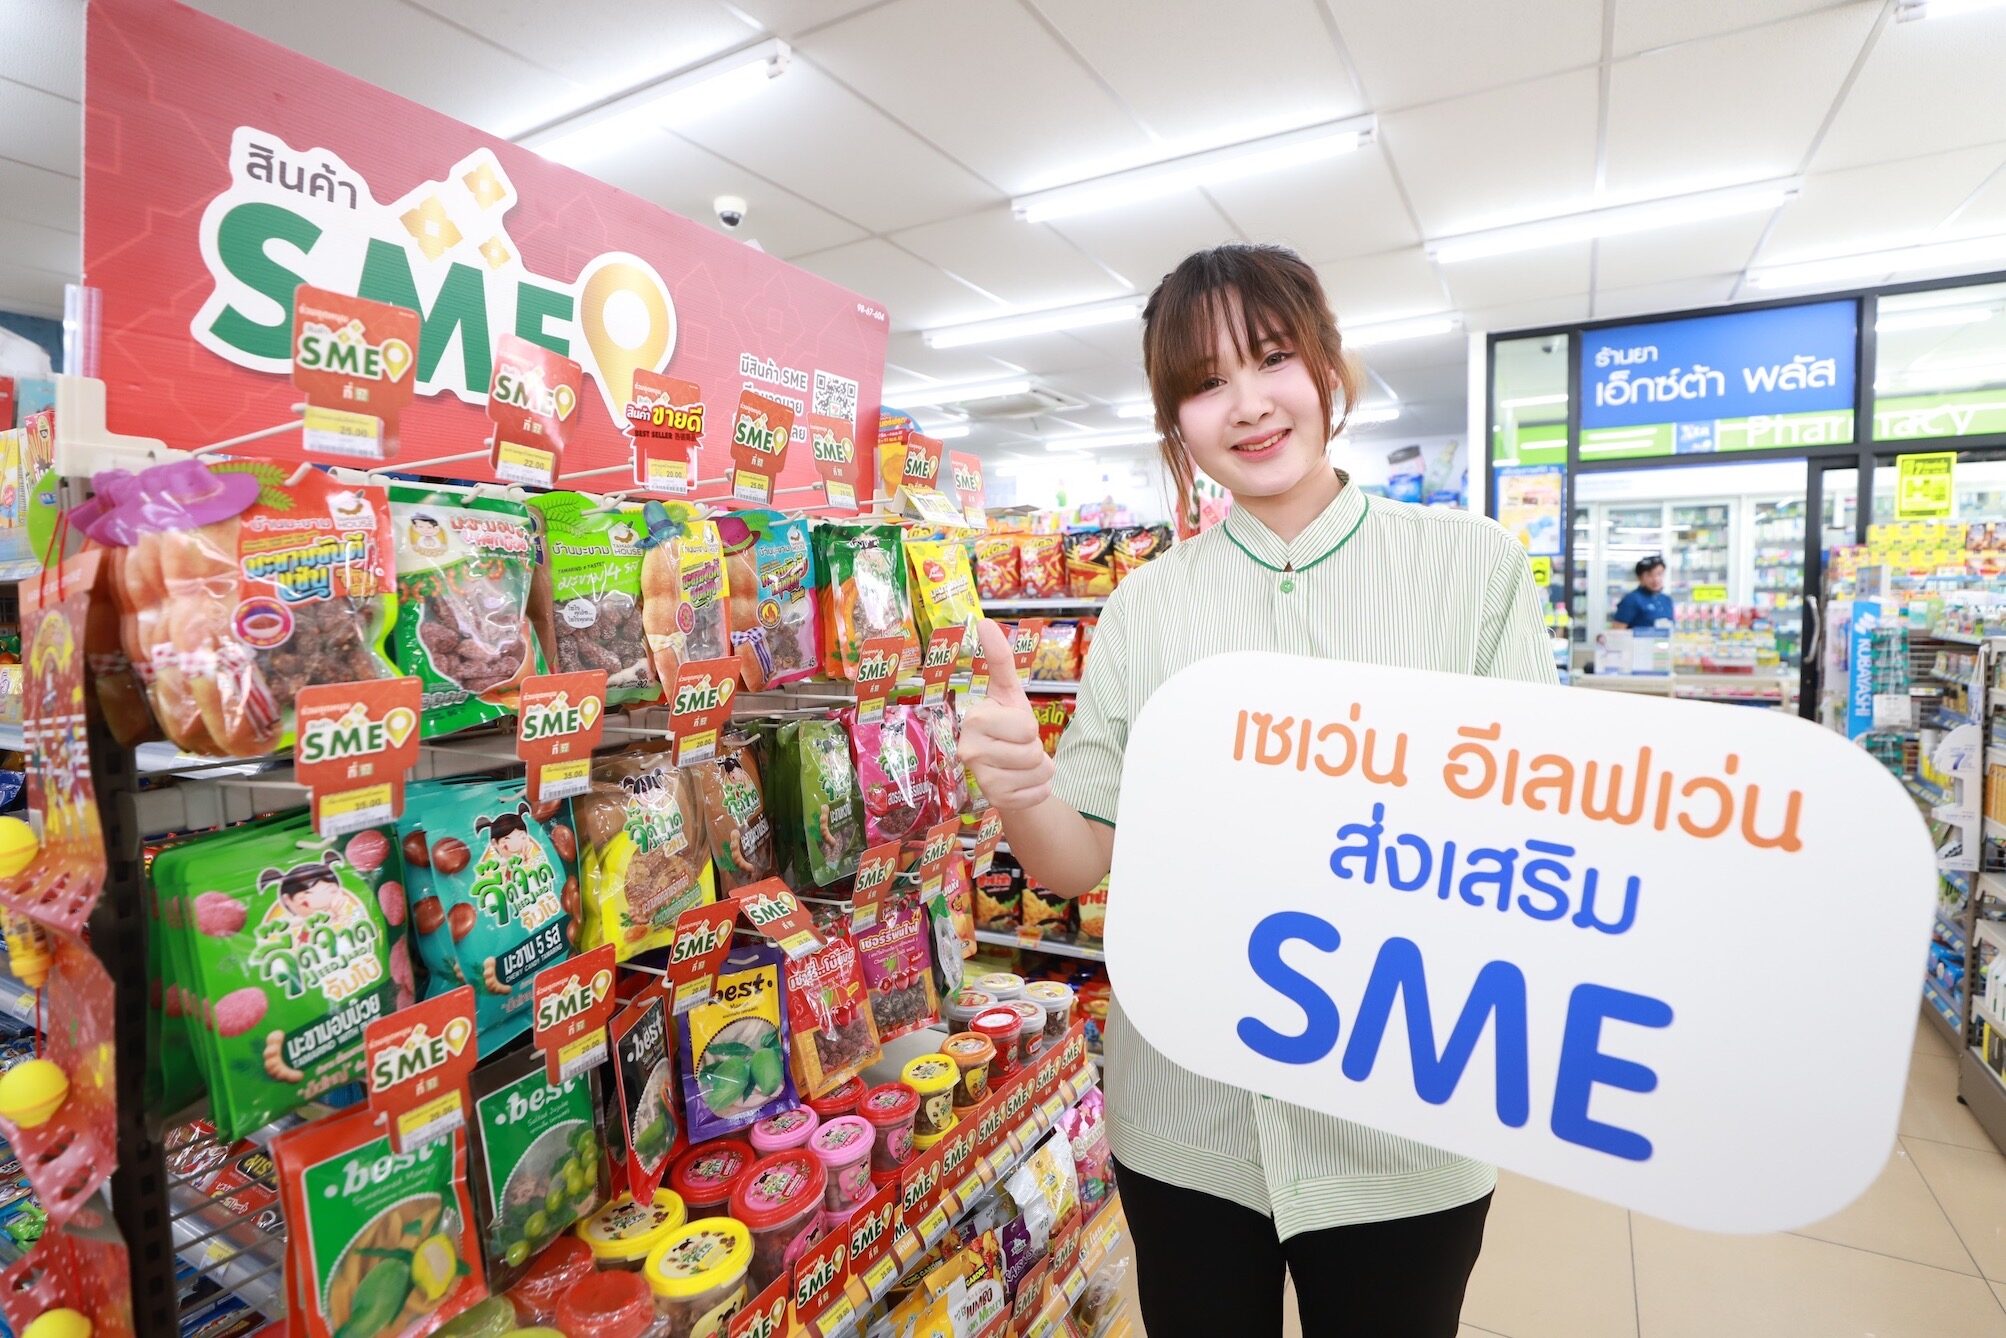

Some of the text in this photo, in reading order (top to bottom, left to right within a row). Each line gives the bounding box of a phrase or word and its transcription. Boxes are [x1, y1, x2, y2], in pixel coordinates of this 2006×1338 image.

[246, 142, 357, 210] สินค้า
[209, 202, 574, 393] SME
[301, 336, 380, 377] SME
[1595, 343, 1658, 368] ร้านยา
[782, 369, 807, 390] SME
[1596, 355, 1836, 407] เอ็กซ์ต้า พลัส
[627, 404, 702, 433] สินค้า ขายดี
[1747, 404, 1977, 449] Pharmacy
[634, 430, 673, 440] BEST SELLER
[735, 422, 773, 451] SME
[813, 440, 844, 461] SME
[904, 458, 929, 477] SME
[955, 473, 976, 491] SME
[552, 541, 611, 556] บ้านมะขาม
[614, 548, 643, 556] HOUSE
[926, 647, 950, 667] SME
[1015, 638, 1032, 653] SME
[859, 660, 888, 681] SME
[674, 688, 718, 714] SME
[523, 708, 579, 739] SME
[304, 723, 383, 761] SME
[696, 738, 712, 748] 20.00
[1233, 703, 1803, 852] เซเว่น อีเลฟเว่น
[978, 823, 997, 842] SME
[923, 843, 946, 865] SME
[857, 868, 884, 891] SME
[1329, 802, 1642, 936] ส่งเสริม
[471, 854, 555, 926] จี๊ดจ๊าด
[749, 900, 790, 925] SME
[249, 911, 376, 998] จี๊ดจ๊าด
[503, 923, 562, 976] มะขาม 5 รส
[672, 932, 716, 962] SME
[505, 943, 563, 983] CHEWY CANDY TAMARIND
[539, 988, 592, 1030] SME
[633, 1008, 665, 1062] best
[1236, 910, 1674, 1162] SME
[375, 1038, 444, 1089] SME
[1062, 1043, 1078, 1069] SME
[1037, 1066, 1055, 1092] SME
[1007, 1090, 1028, 1119] SME
[978, 1116, 1001, 1144] SME
[943, 1143, 968, 1176] SME
[904, 1176, 931, 1211] SME
[851, 1218, 882, 1258] SME
[1052, 1247, 1077, 1271] SME
[798, 1263, 834, 1306] SME
[966, 1265, 988, 1287] GARDEN
[965, 1287, 993, 1320] JUMBO
[1015, 1288, 1036, 1320] SME
